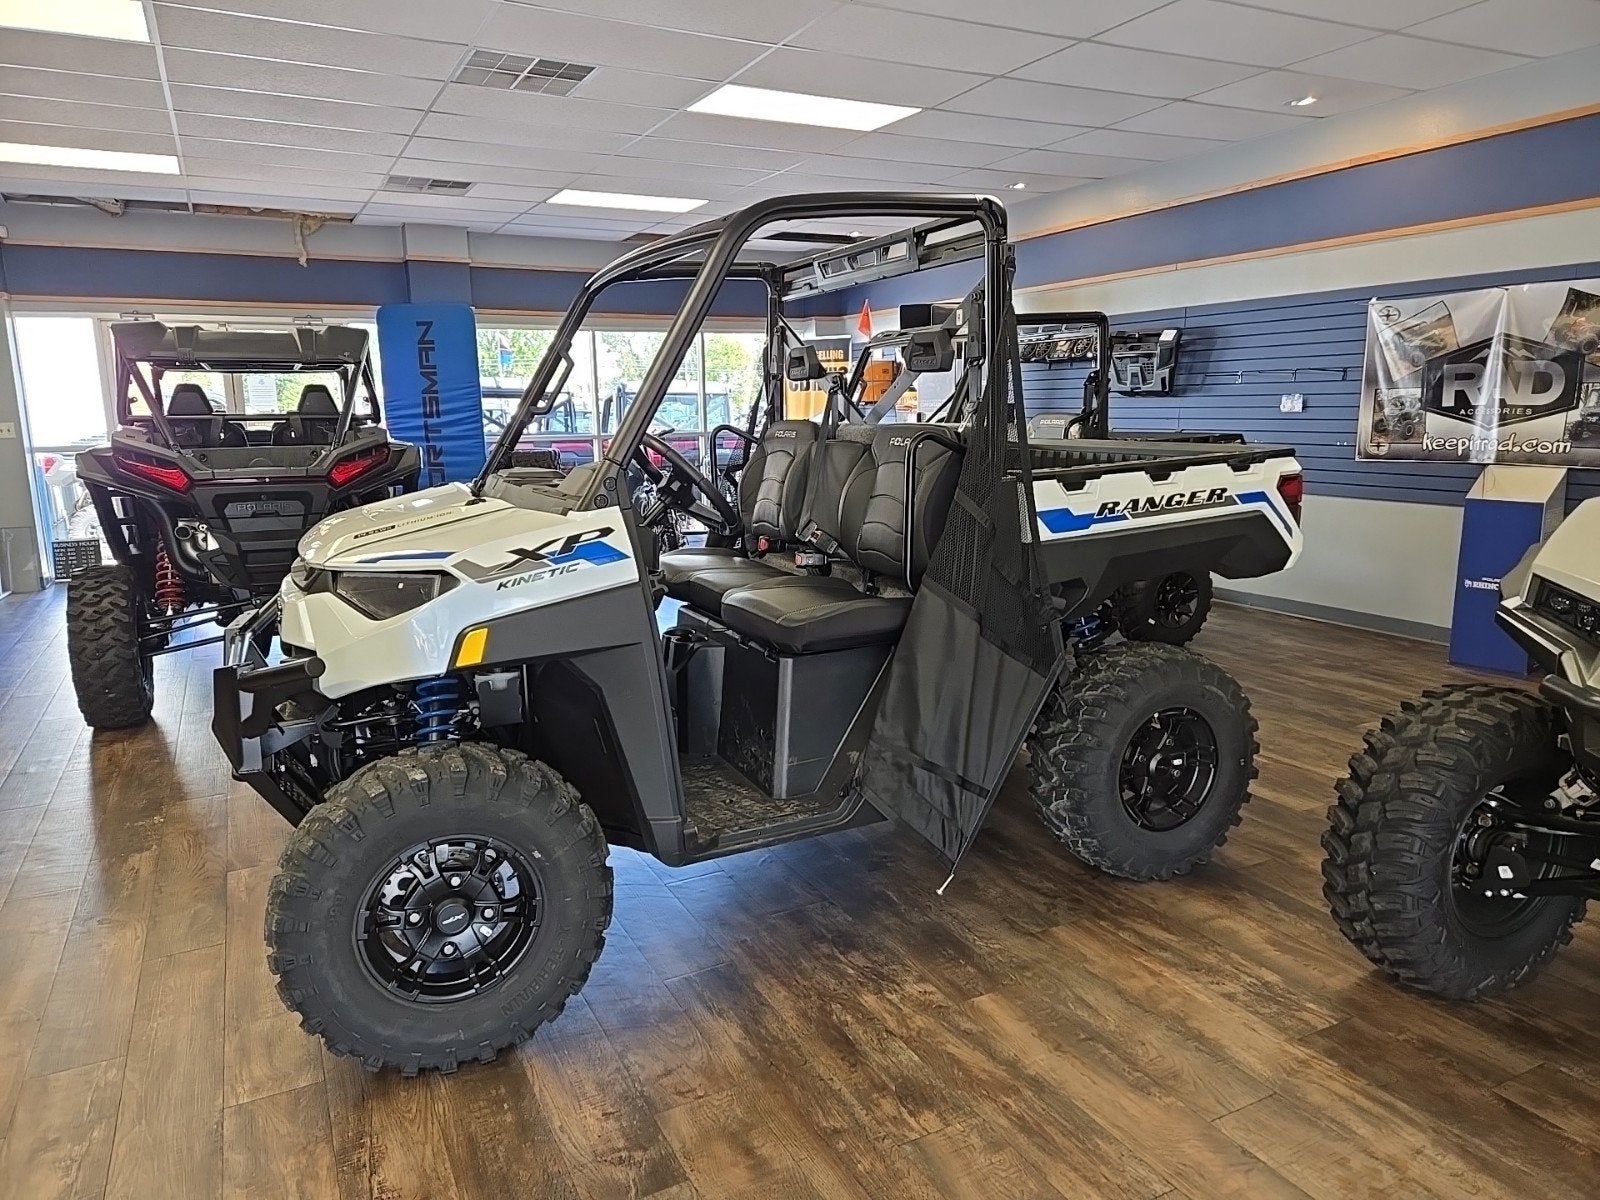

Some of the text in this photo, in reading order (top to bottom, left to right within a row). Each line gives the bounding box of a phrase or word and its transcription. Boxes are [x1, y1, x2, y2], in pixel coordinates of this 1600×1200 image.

[1441, 359, 1566, 408] RAD
[1459, 407, 1533, 416] ACCESSORIES
[774, 430, 797, 438] POLARIS
[1421, 431, 1573, 456] keepitrad.com
[236, 503, 293, 513] POLARIS
[1094, 487, 1228, 518] RANGER
[494, 526, 616, 573] XP
[496, 562, 581, 592] KINETIC
